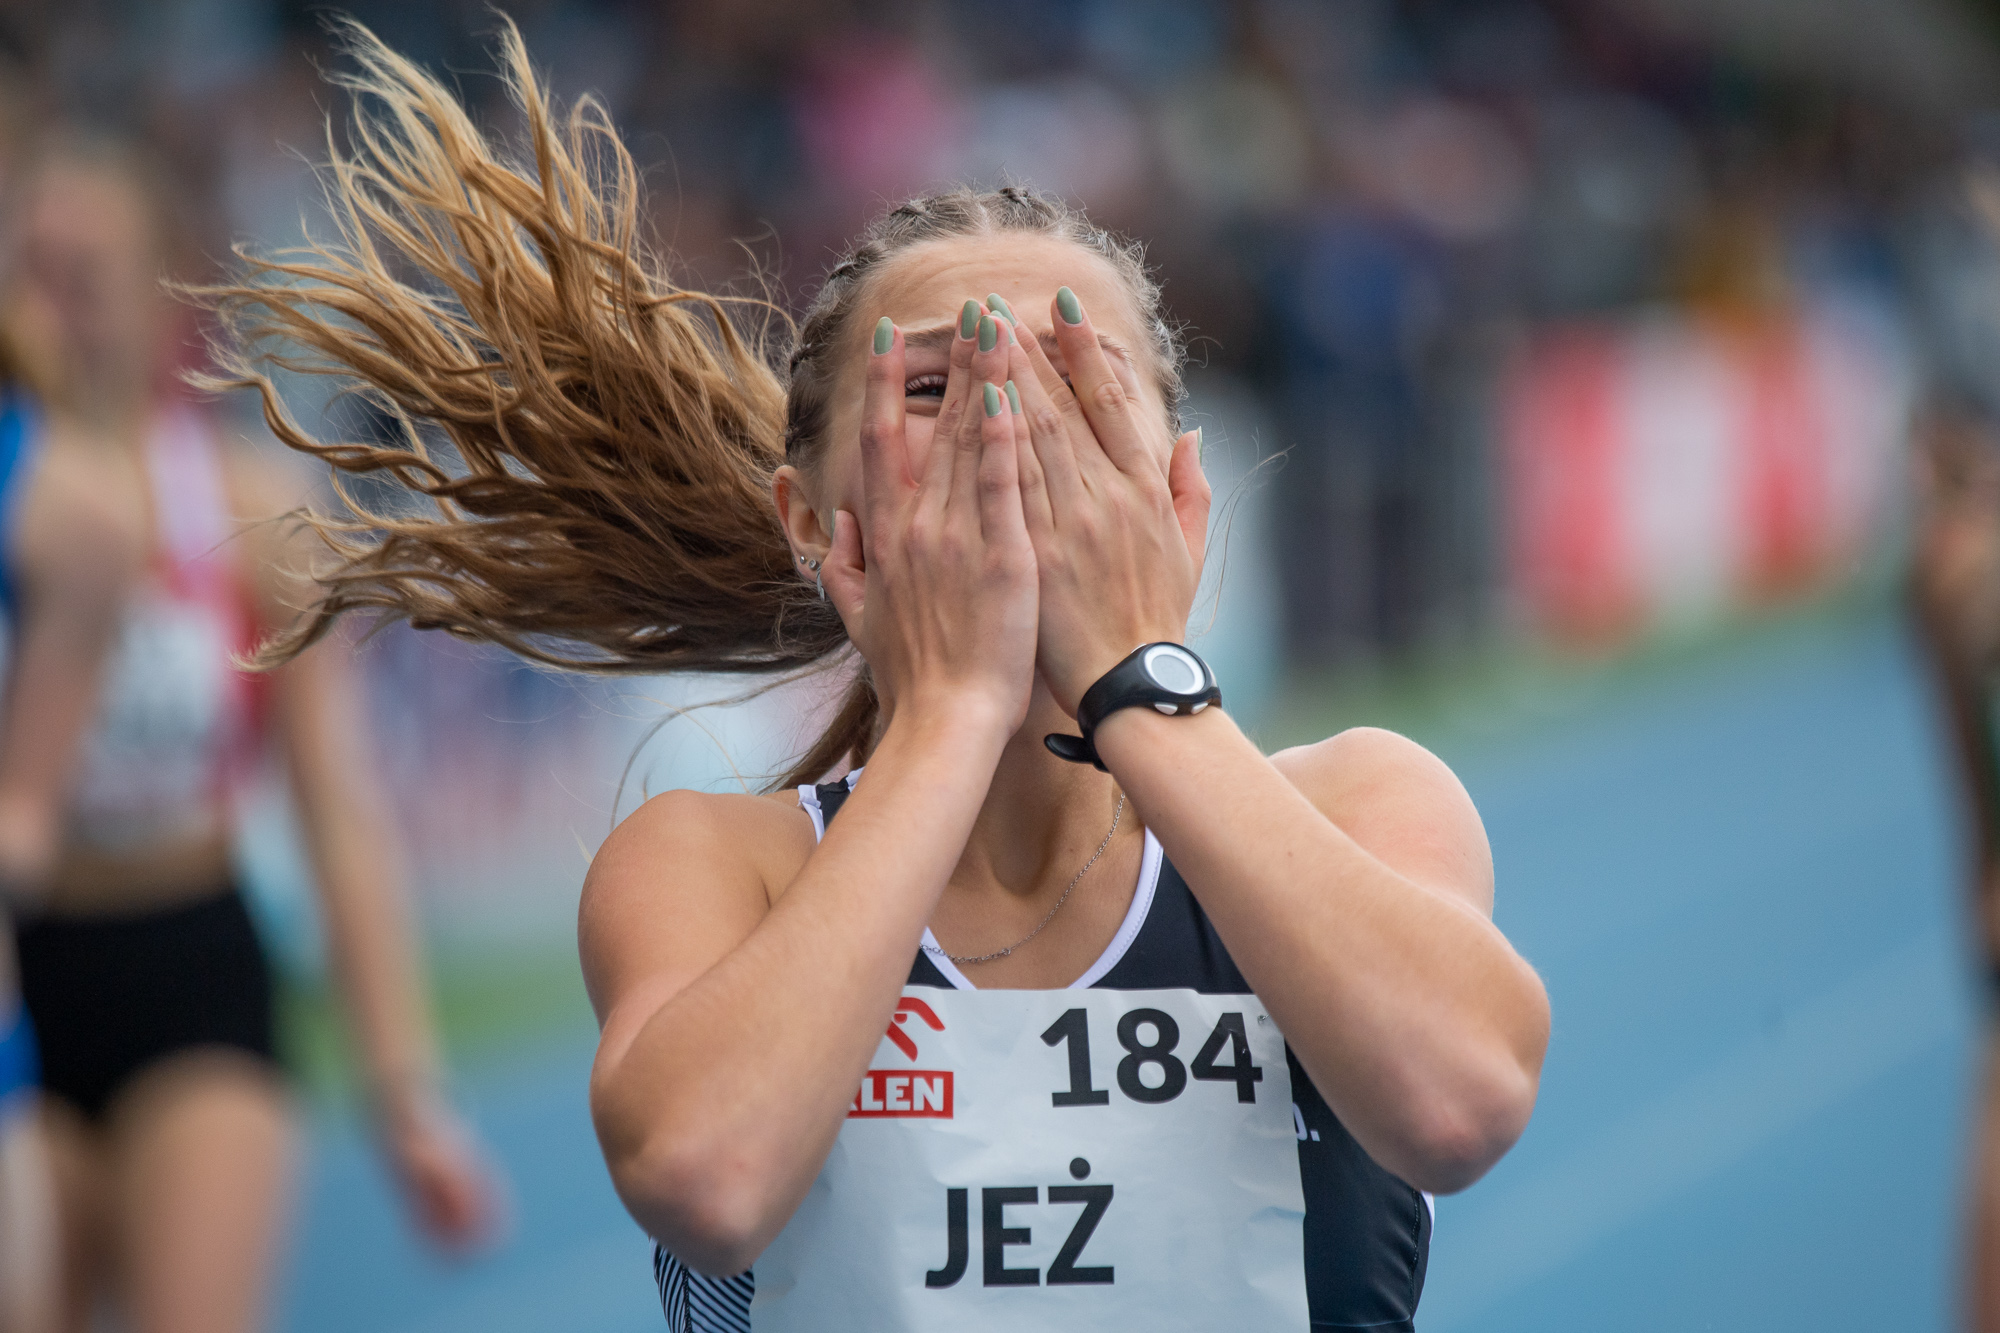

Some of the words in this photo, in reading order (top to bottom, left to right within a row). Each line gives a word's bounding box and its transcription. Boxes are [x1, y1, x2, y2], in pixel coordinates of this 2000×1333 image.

[850, 1077, 944, 1112] LEN
[1040, 1007, 1263, 1107] 184
[925, 1157, 1115, 1289] JEŻ
